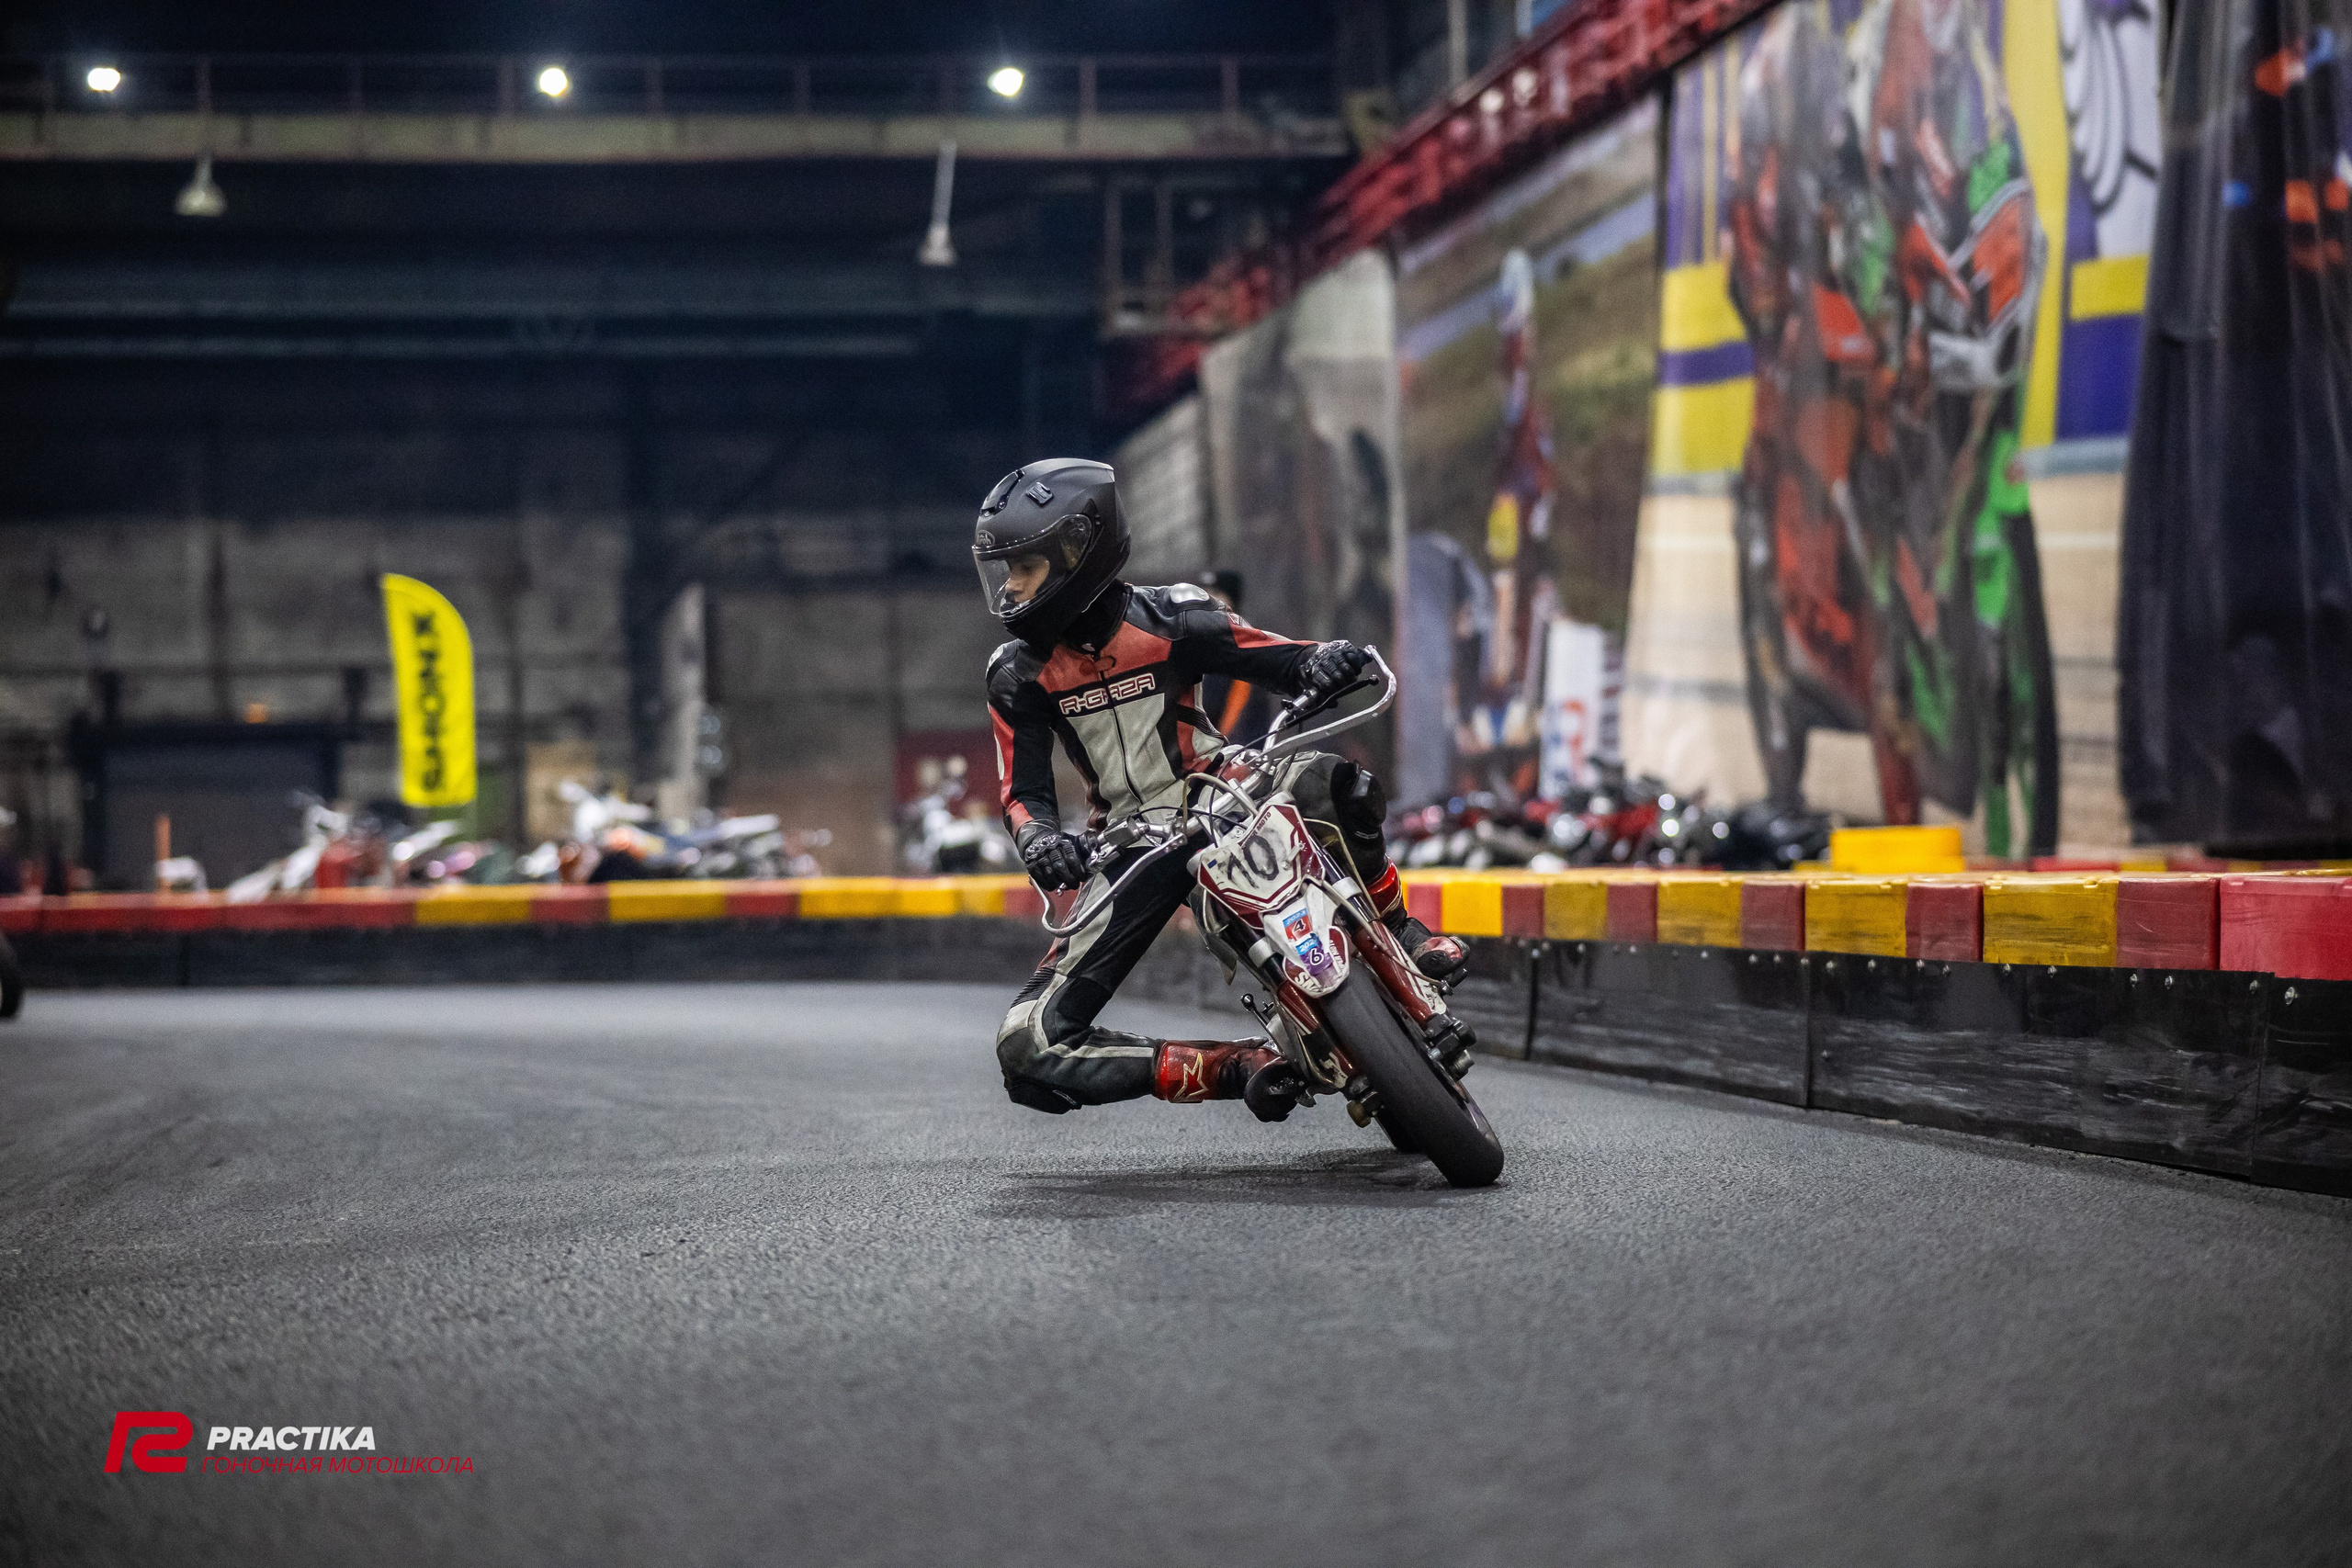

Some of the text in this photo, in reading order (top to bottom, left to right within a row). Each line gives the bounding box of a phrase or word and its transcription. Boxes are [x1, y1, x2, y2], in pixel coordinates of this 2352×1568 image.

[1059, 672, 1156, 715] R-GAZA
[1292, 919, 1306, 933] 4
[1310, 948, 1324, 965] 6
